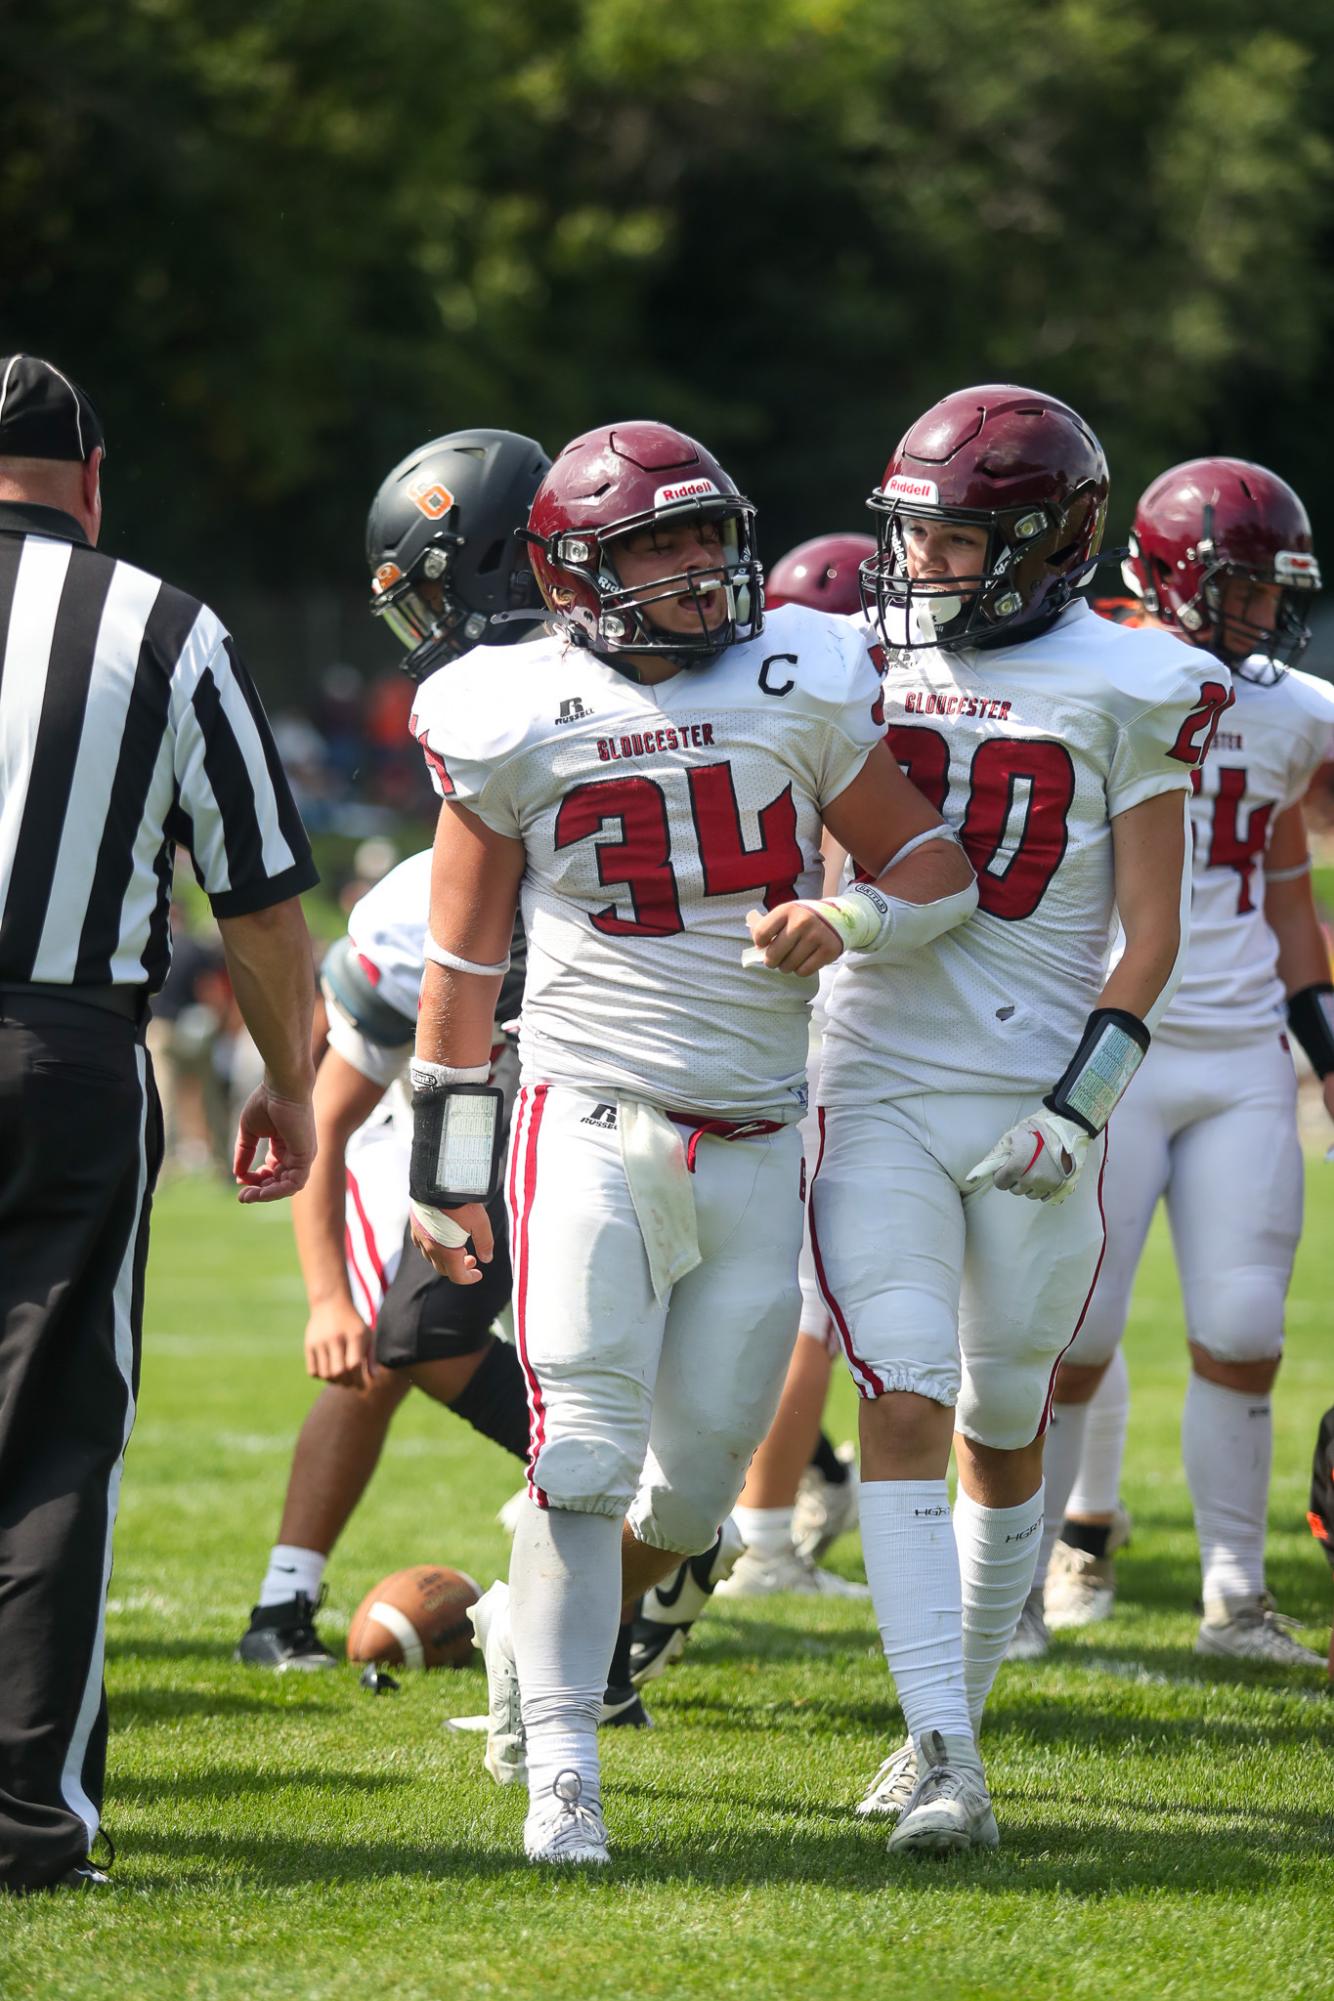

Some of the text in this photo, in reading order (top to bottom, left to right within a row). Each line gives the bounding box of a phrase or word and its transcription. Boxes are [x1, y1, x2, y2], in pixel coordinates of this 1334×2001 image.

[662, 481, 712, 501] Riddell
[890, 480, 930, 497] Riddell
[758, 653, 798, 697] C
[554, 708, 595, 726] RUSSELL
[904, 691, 1012, 721] GLOUCESTER
[597, 722, 715, 762] GLOUCESTER
[554, 760, 804, 937] 34
[580, 1117, 617, 1130] RUSSE
